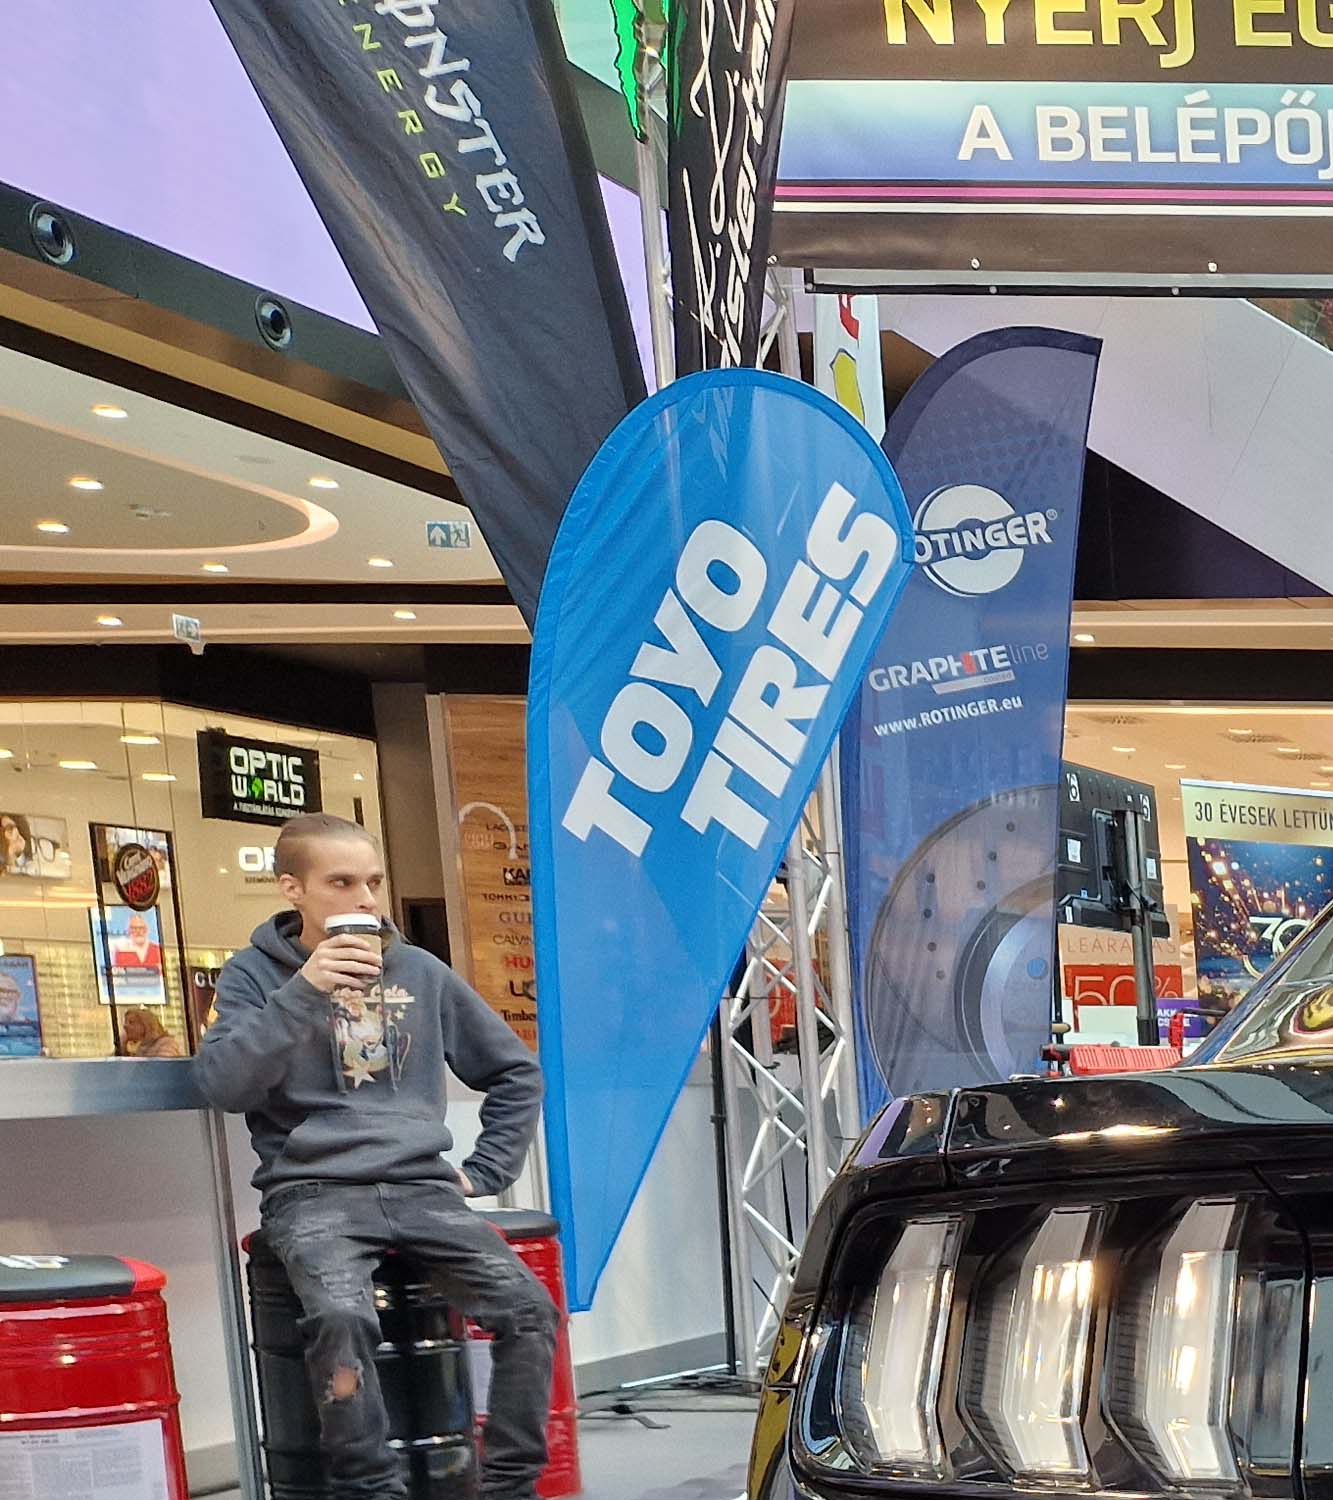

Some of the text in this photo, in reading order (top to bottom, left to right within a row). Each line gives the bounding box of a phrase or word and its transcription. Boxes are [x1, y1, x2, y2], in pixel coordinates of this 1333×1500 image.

[883, 0, 1196, 69] NYERJ
[338, 0, 467, 217] NERGY
[375, 0, 546, 262] ONSTER
[957, 104, 1014, 161] A
[913, 510, 1054, 564] OTINGER
[561, 519, 768, 859] TOYO
[680, 481, 898, 851] TIRES
[874, 696, 1024, 737] www.ROTINGER.eu
[229, 746, 304, 785] OPTIC
[1194, 801, 1213, 823] 30
[1219, 798, 1278, 829] ÉVESEK
[1067, 933, 1178, 955] LEÁRAÁS
